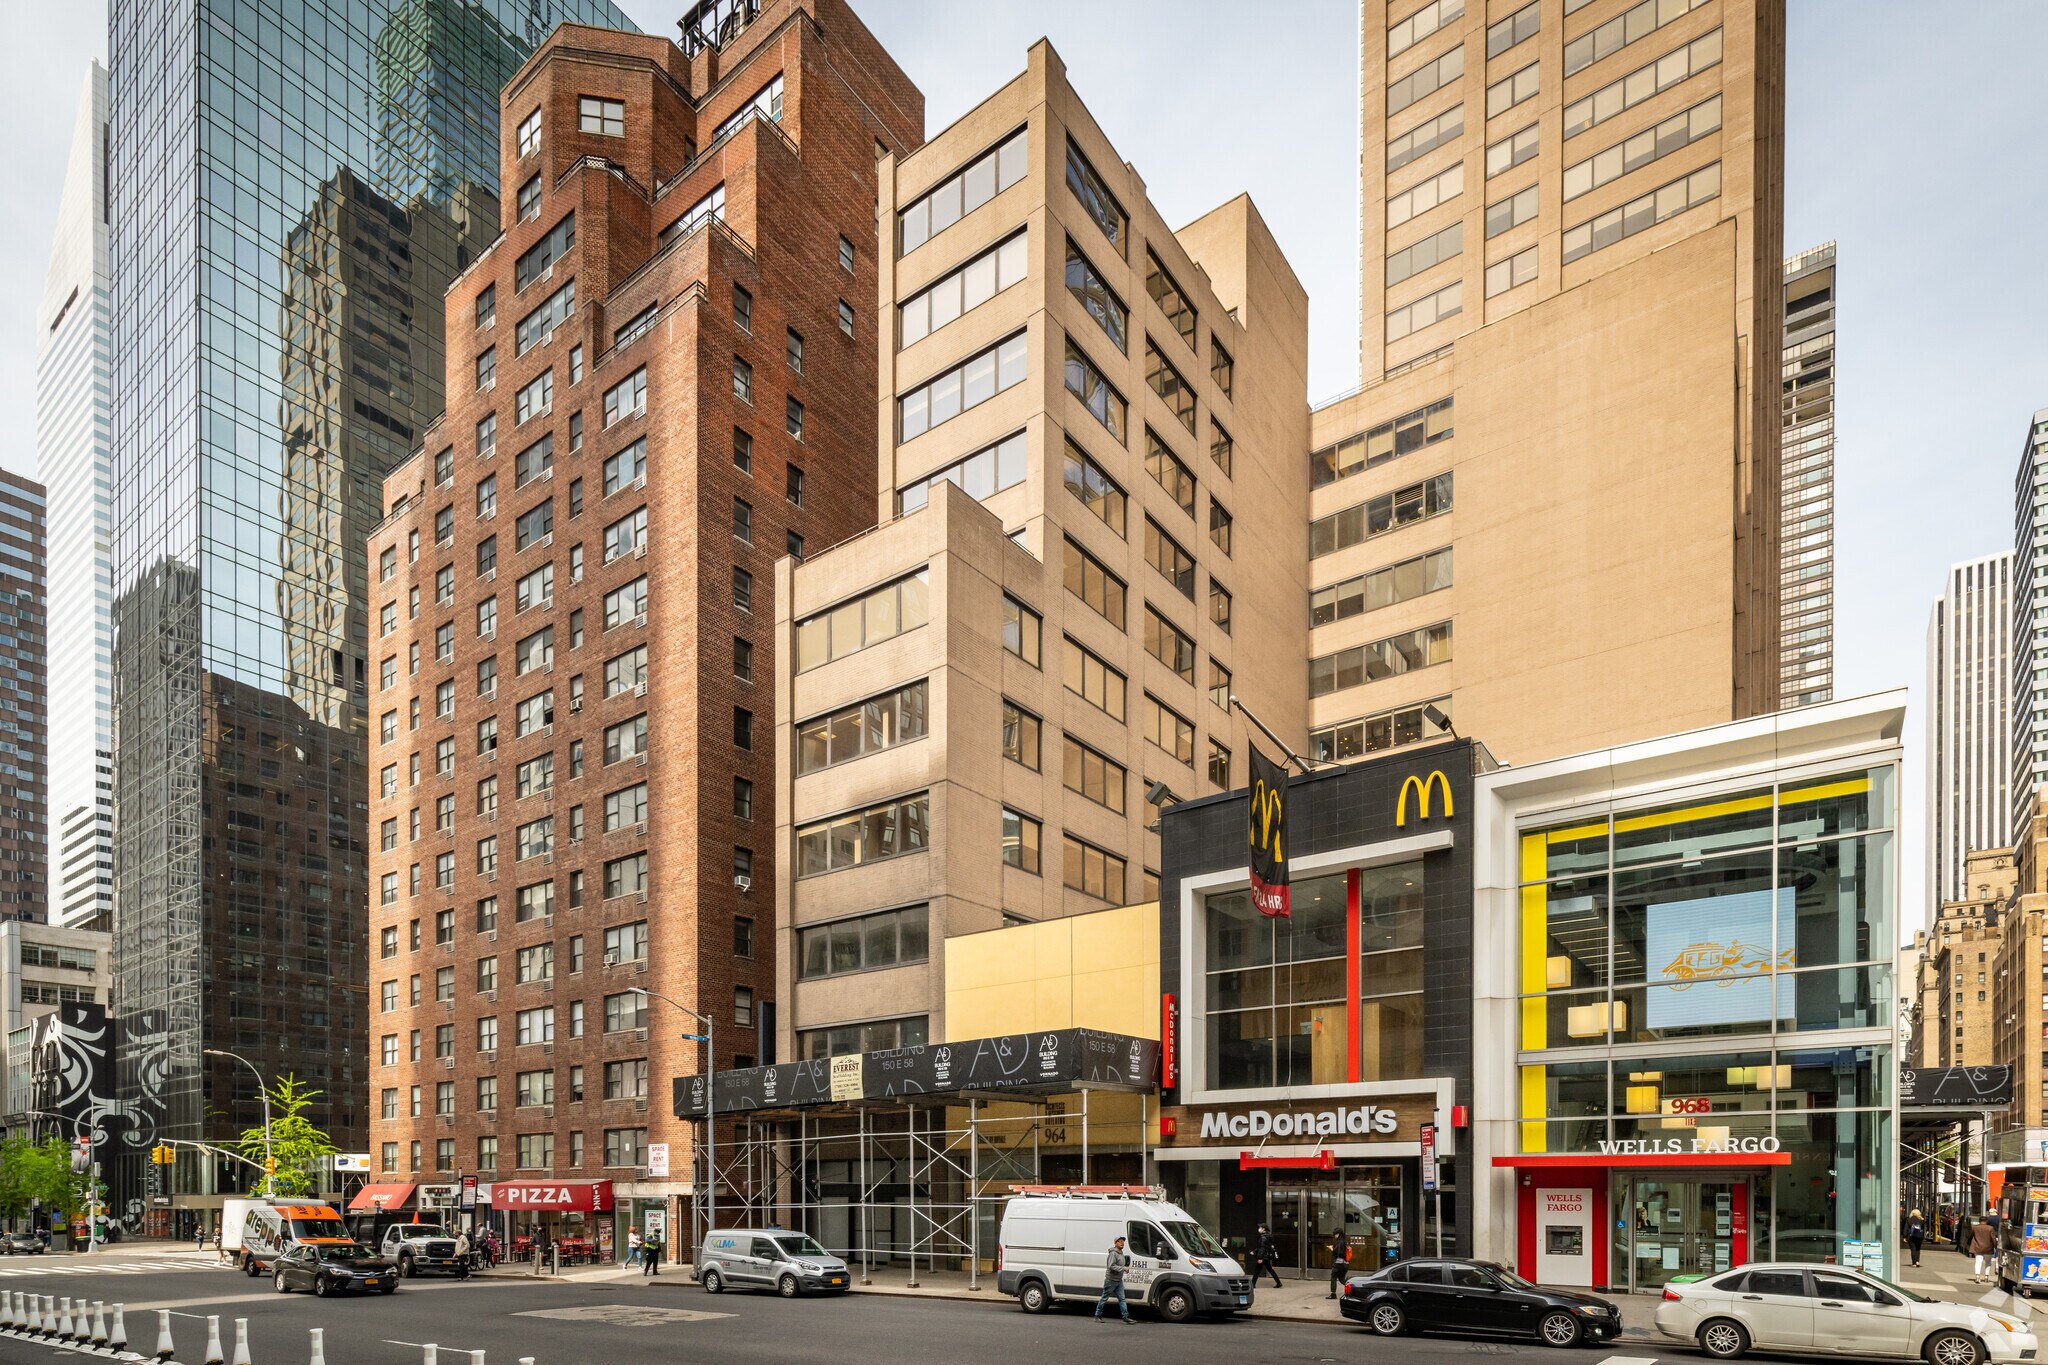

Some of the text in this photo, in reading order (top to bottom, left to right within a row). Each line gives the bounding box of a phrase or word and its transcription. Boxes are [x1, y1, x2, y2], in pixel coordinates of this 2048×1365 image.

[1089, 1041, 1100, 1052] 150
[1107, 1043, 1116, 1054] 58
[833, 1063, 860, 1073] EVEREST
[882, 1058, 914, 1070] 150 E 58
[725, 1079, 736, 1088] 150
[742, 1077, 750, 1086] 58
[1671, 1098, 1710, 1115] 968
[1200, 1106, 1397, 1138] McDonald's
[1045, 1128, 1066, 1144] 964
[1597, 1136, 1781, 1155] WELLS FARGO
[508, 1187, 573, 1204] PIZZA
[592, 1184, 602, 1211] PIZZA
[1132, 1260, 1147, 1268] H&H
